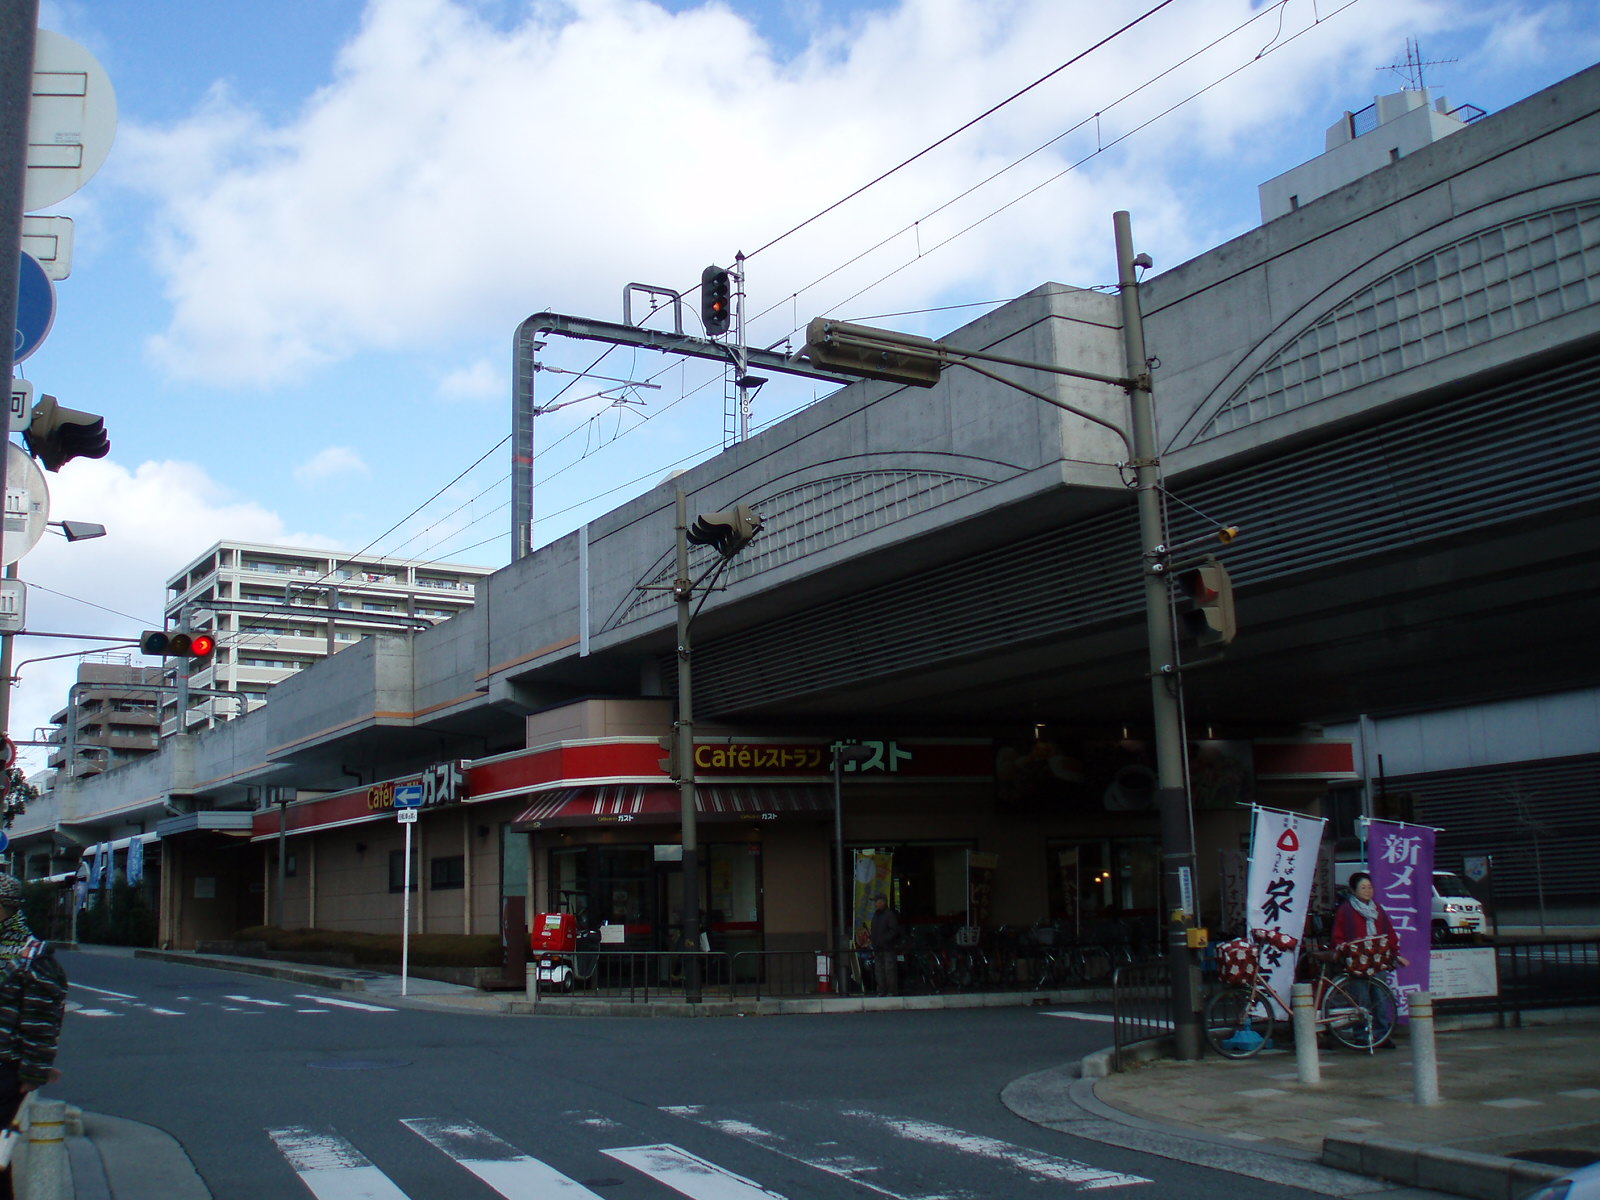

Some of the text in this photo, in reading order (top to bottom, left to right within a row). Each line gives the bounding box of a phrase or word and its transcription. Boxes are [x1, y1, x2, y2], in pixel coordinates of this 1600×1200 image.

[694, 745, 821, 769] Caféレストラン
[422, 763, 463, 806] ガスト
[617, 814, 634, 822] ガスト
[761, 812, 778, 820] ガスト
[1380, 833, 1422, 948] 新メニュ
